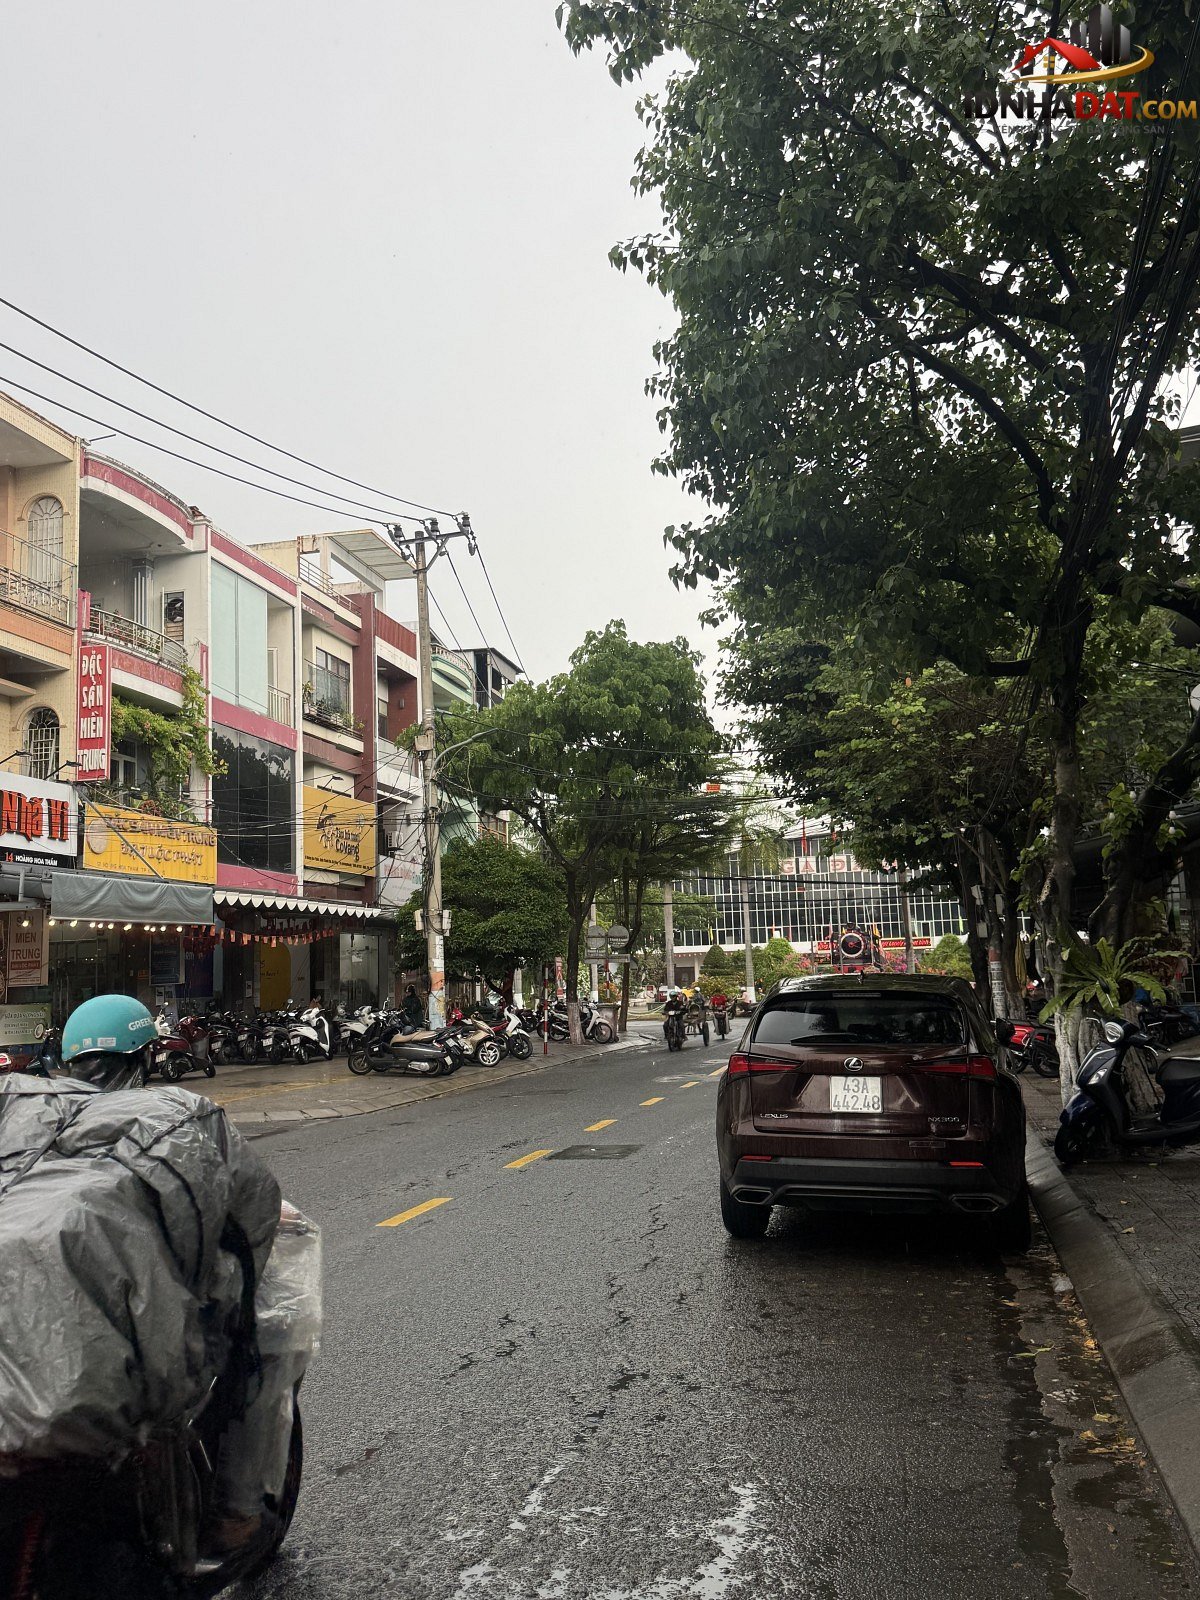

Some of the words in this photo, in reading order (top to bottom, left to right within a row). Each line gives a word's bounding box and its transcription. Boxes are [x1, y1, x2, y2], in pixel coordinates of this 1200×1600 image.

[82, 650, 102, 677] ĐẶC
[82, 677, 103, 709] SẢN
[80, 711, 103, 739] MIỀN
[78, 748, 106, 772] TRUNG
[5, 852, 14, 862] 14
[15, 854, 34, 864] HOÀNG
[782, 859, 815, 873] GA
[11, 948, 41, 960] TRUNG
[843, 1076, 869, 1094] 43A
[832, 1094, 881, 1111] 442.48
